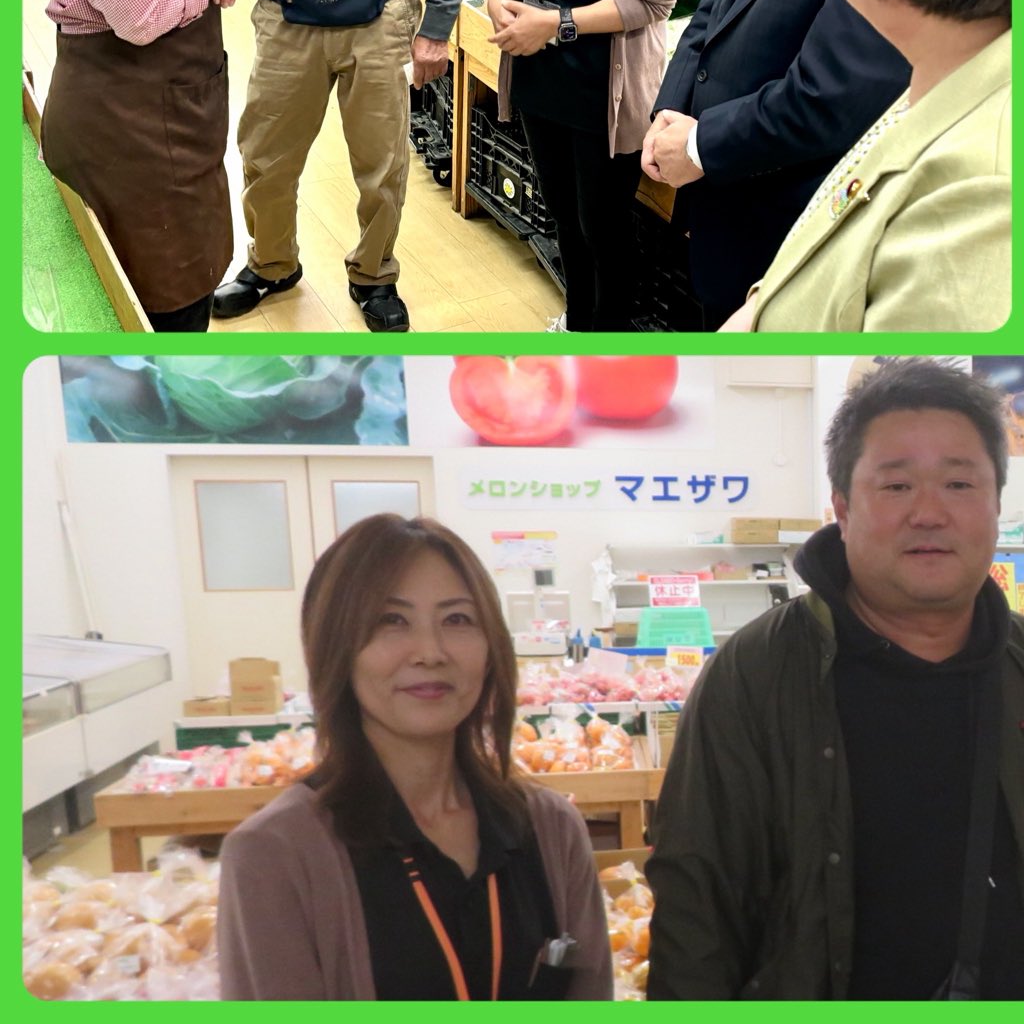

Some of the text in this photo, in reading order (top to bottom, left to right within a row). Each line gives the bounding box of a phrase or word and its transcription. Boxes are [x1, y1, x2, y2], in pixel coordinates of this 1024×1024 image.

[468, 474, 752, 505] メロンショップ マエザワ
[655, 585, 695, 596] 休止中
